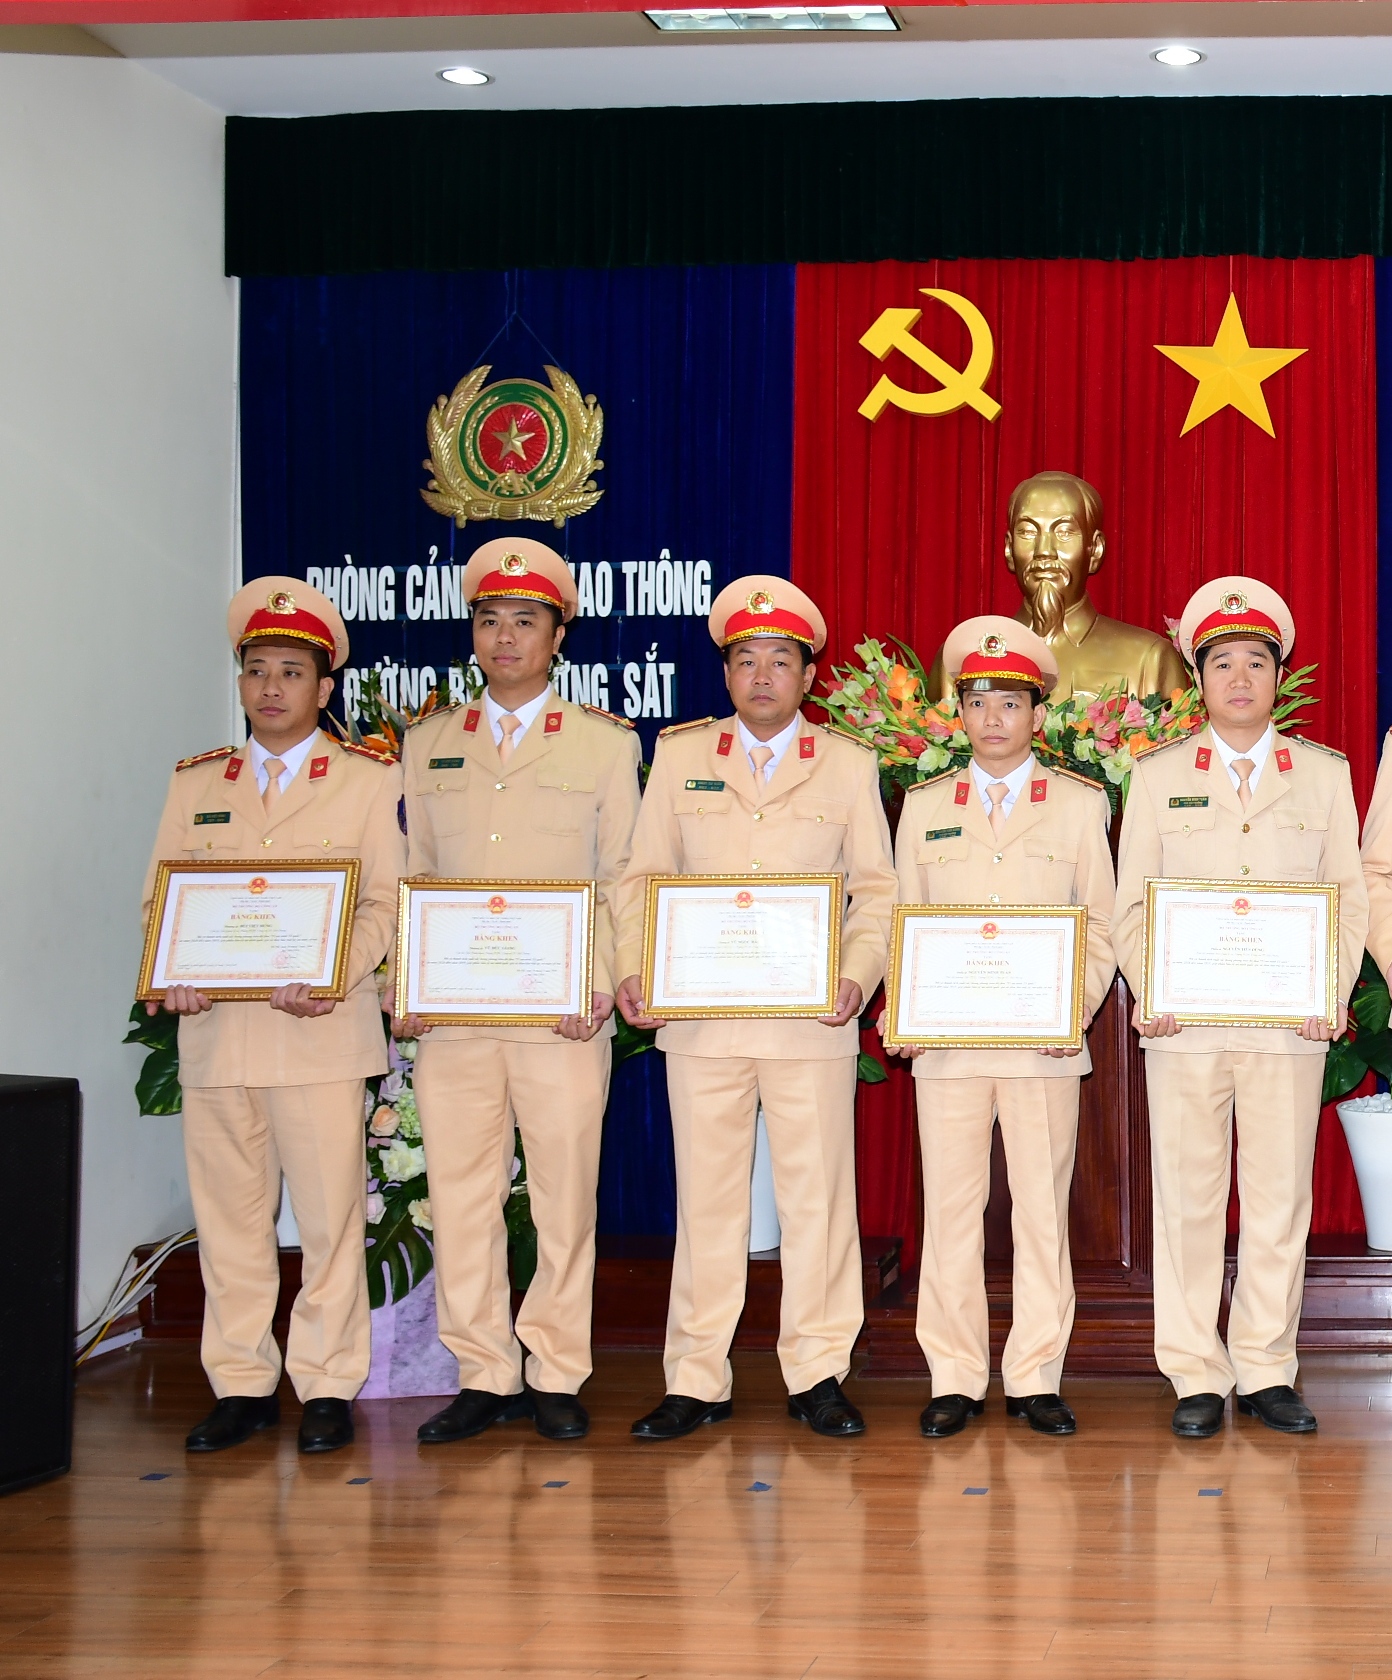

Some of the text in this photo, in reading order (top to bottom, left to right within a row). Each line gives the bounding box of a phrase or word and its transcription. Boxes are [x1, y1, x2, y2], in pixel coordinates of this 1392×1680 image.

[568, 561, 613, 617] AO
[621, 548, 712, 616] THÔNG
[623, 642, 675, 719] SẮT
